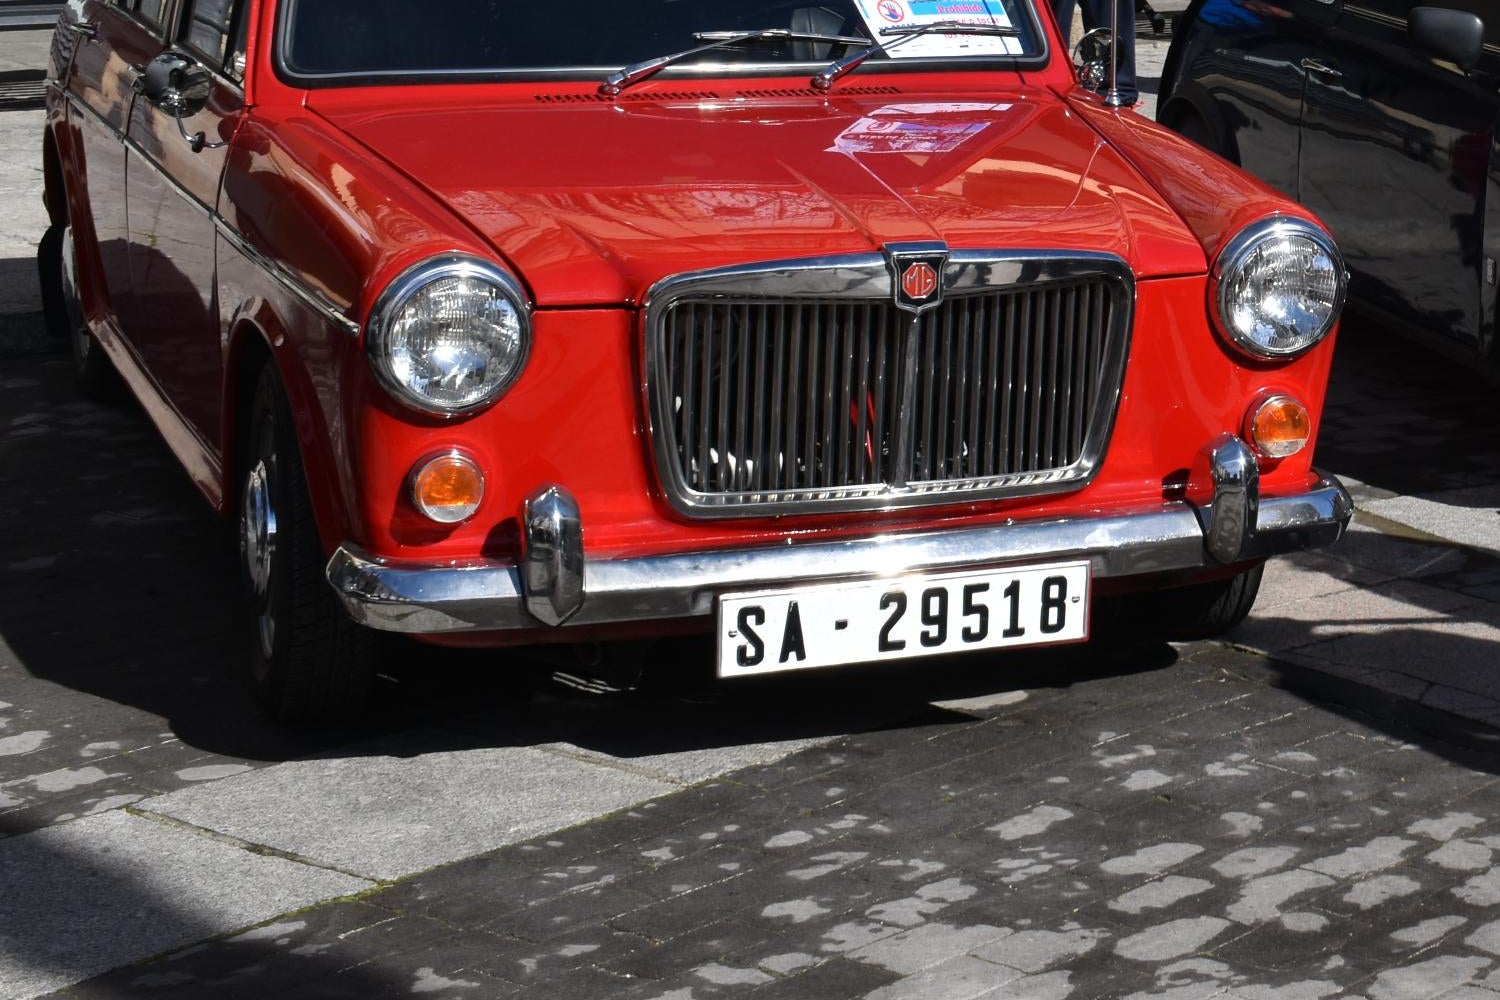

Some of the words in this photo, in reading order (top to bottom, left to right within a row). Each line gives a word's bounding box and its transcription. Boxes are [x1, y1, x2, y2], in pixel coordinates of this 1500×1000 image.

[937, 4, 983, 14] Prohibido
[906, 266, 933, 295] MG
[737, 600, 806, 668] SA
[878, 575, 1068, 653] 29518
